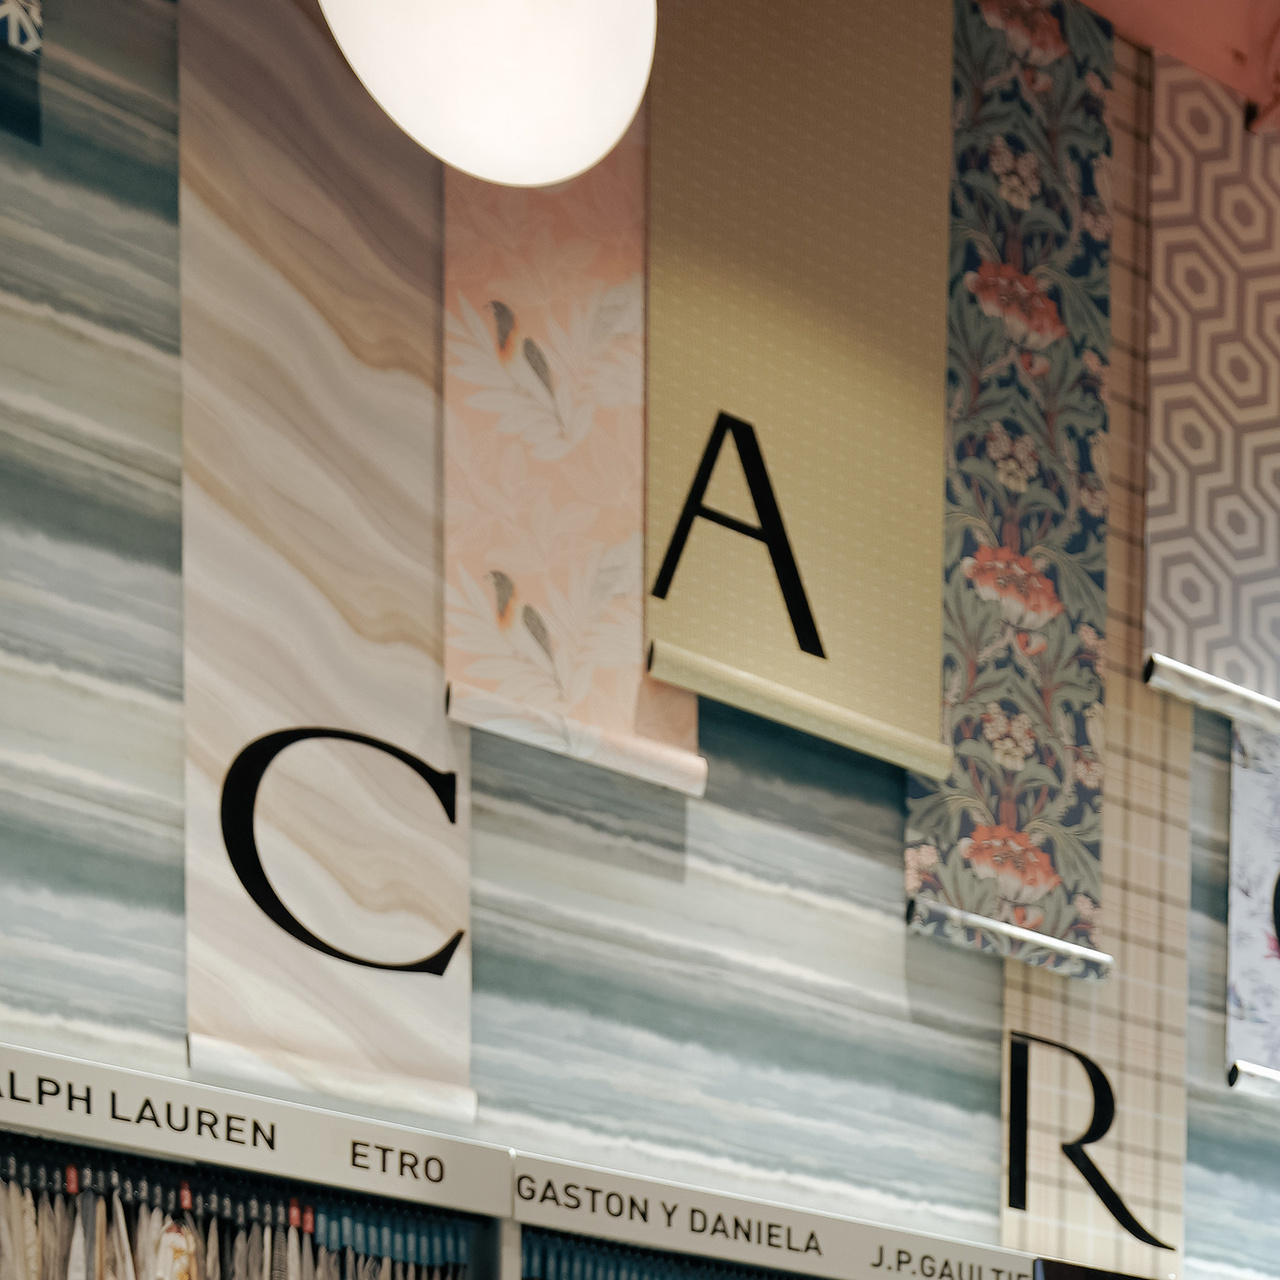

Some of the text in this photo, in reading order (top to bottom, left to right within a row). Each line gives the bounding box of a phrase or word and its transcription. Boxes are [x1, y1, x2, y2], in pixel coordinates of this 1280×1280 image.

[652, 410, 827, 660] A
[221, 727, 465, 976] C
[0, 1070, 277, 1151] LPH LAUREN
[350, 1140, 445, 1184] ETRO
[1008, 1030, 1176, 1251] R
[516, 1174, 824, 1257] GASTON Y DANIELA
